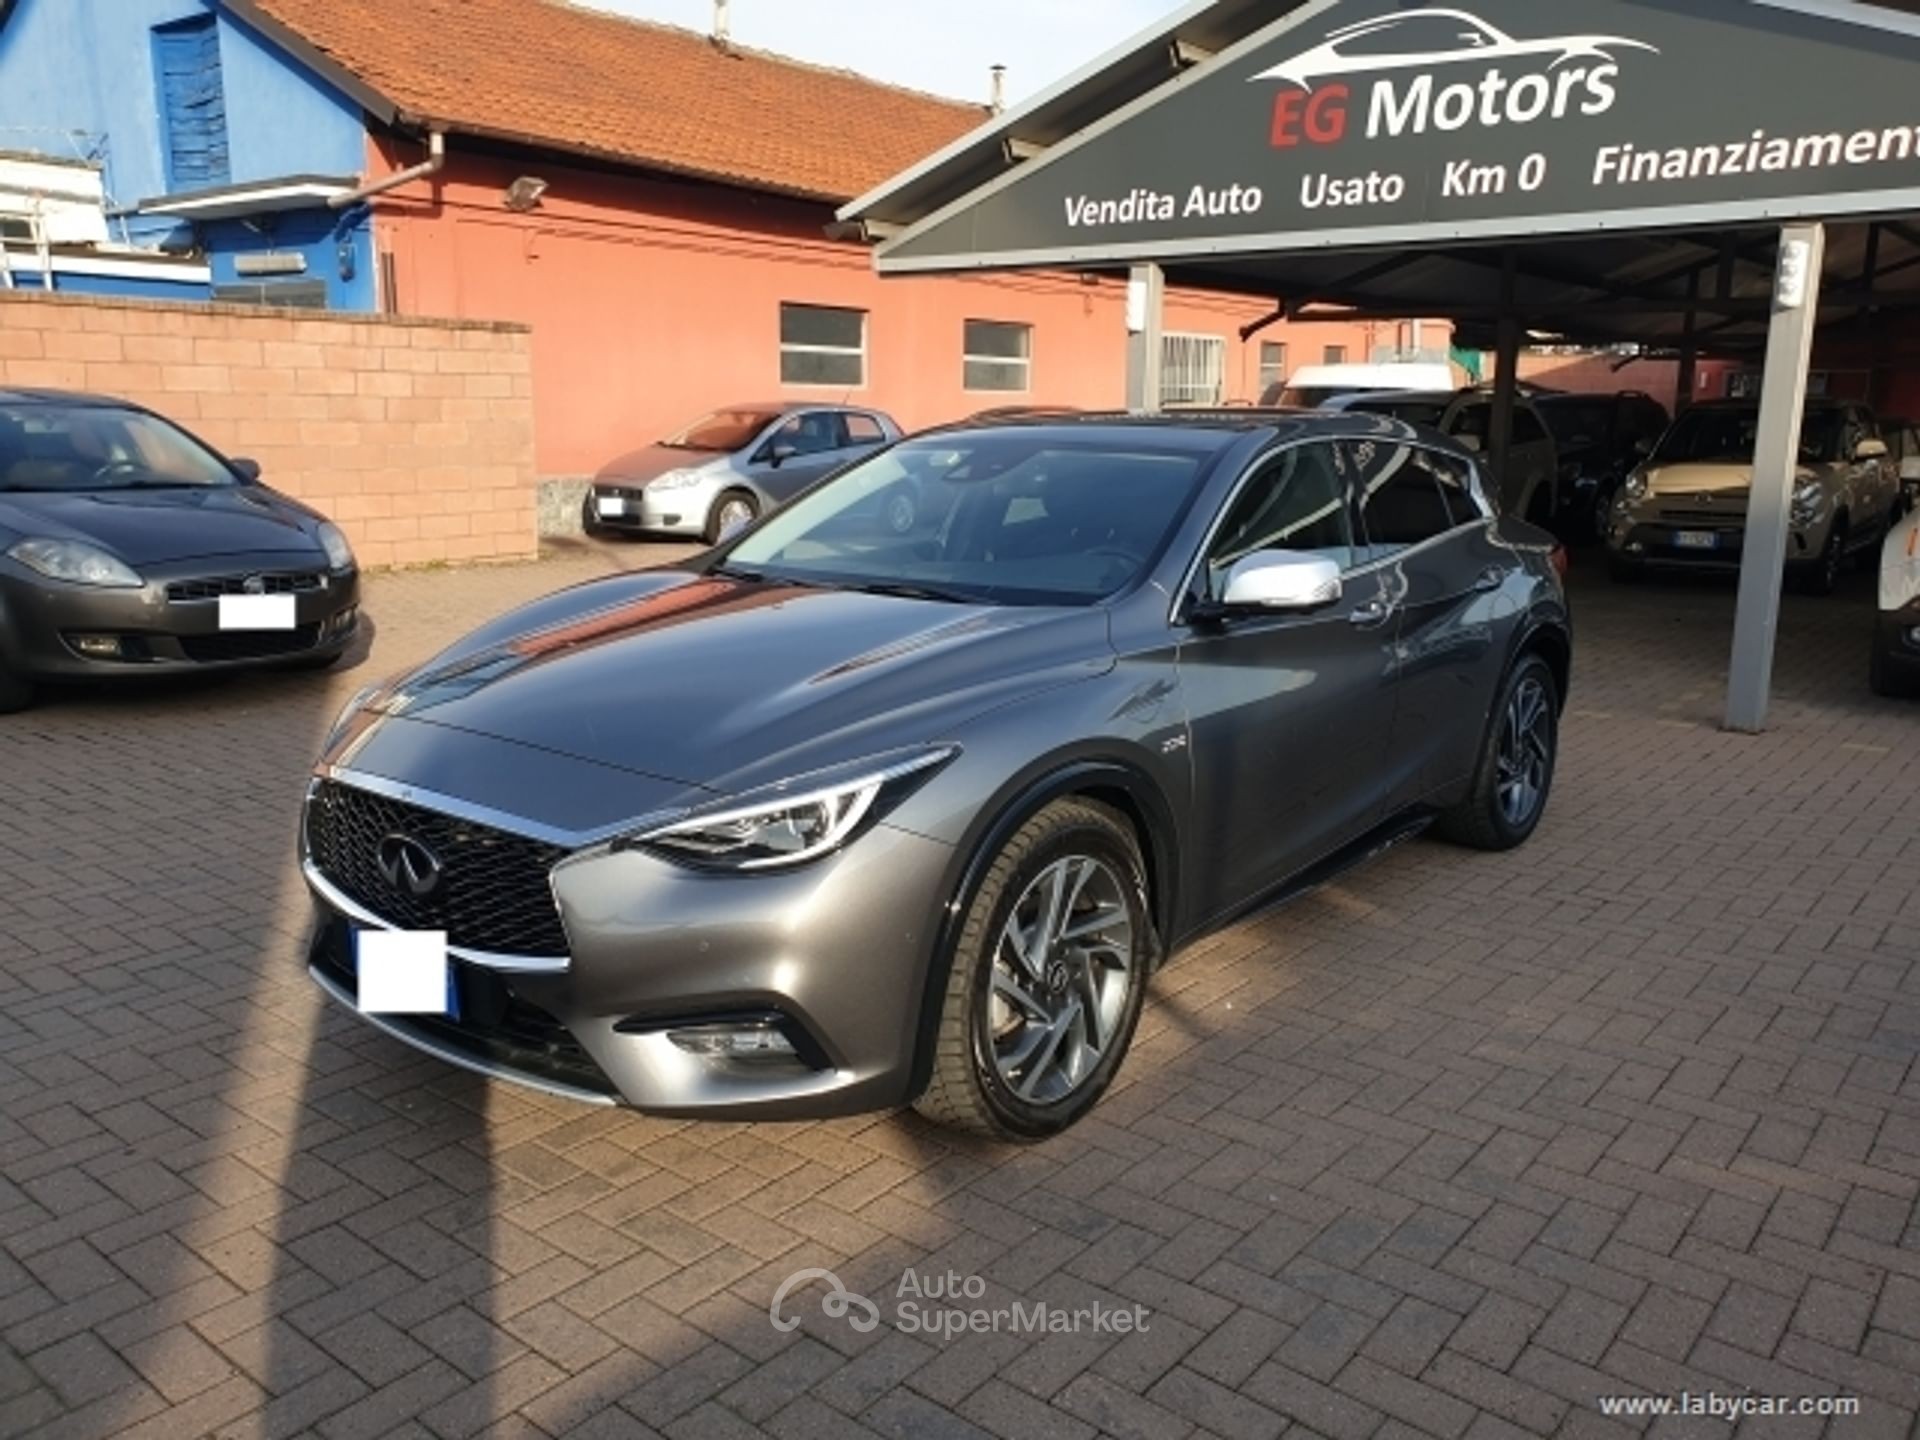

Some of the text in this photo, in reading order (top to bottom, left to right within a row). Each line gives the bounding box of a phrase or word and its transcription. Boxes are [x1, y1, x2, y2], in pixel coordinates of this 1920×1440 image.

[1269, 64, 1618, 147] EG Motors
[1065, 188, 1175, 226] Vendita
[1183, 183, 1263, 217] Auto
[1301, 170, 1405, 208] Usato
[1442, 159, 1506, 197] Km
[1518, 153, 1547, 191] 0
